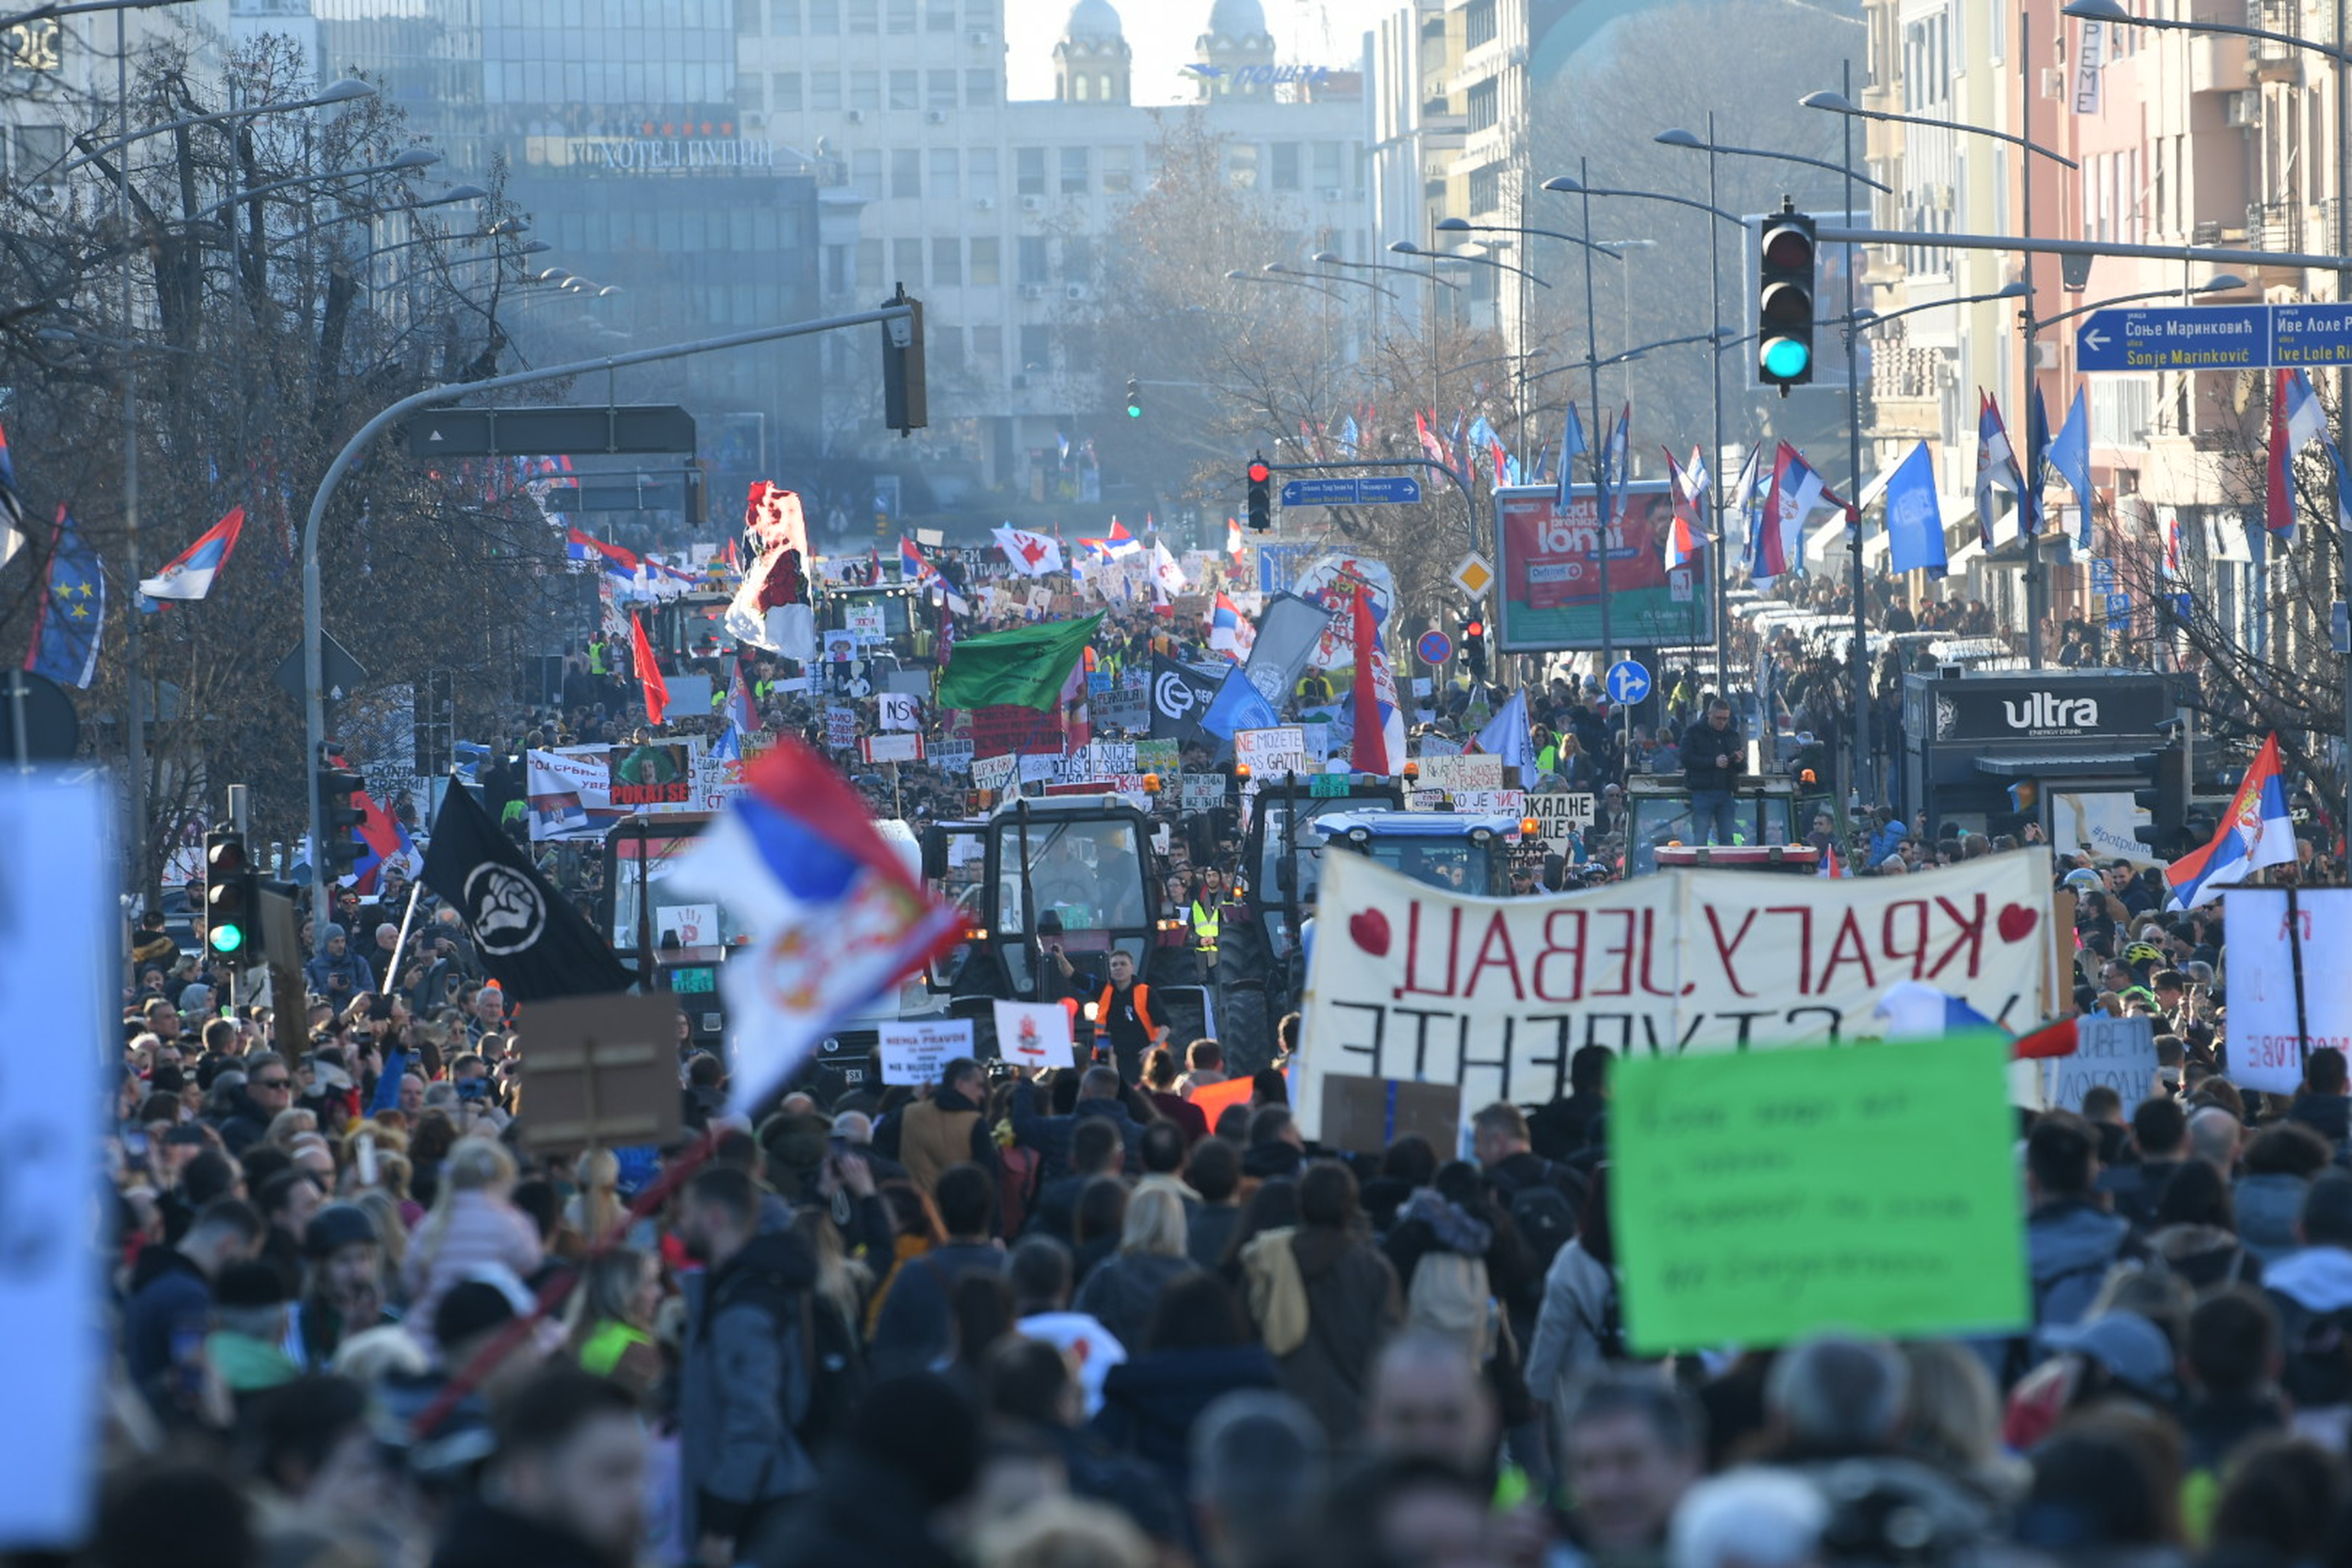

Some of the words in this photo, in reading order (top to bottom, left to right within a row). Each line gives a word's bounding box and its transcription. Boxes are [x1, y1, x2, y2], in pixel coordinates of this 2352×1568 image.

[1233, 65, 1329, 85] ПОШТА
[602, 140, 680, 169] ХОТЕЛ
[687, 138, 773, 167] ПУПИН
[2125, 321, 2163, 336] Соње
[2166, 319, 2253, 339] Маринковић
[2278, 318, 2302, 333] Иве
[2307, 317, 2340, 332] Лоле
[2127, 350, 2167, 367] Sonje
[2171, 348, 2250, 365] Marinković
[2278, 346, 2299, 361] Ive
[2304, 345, 2332, 360] Lole
[2002, 691, 2100, 728] ultra
[1237, 733, 1255, 752] NE
[1102, 745, 1134, 760] NIJE
[612, 785, 665, 805] POKAJ
[667, 783, 689, 802] SE
